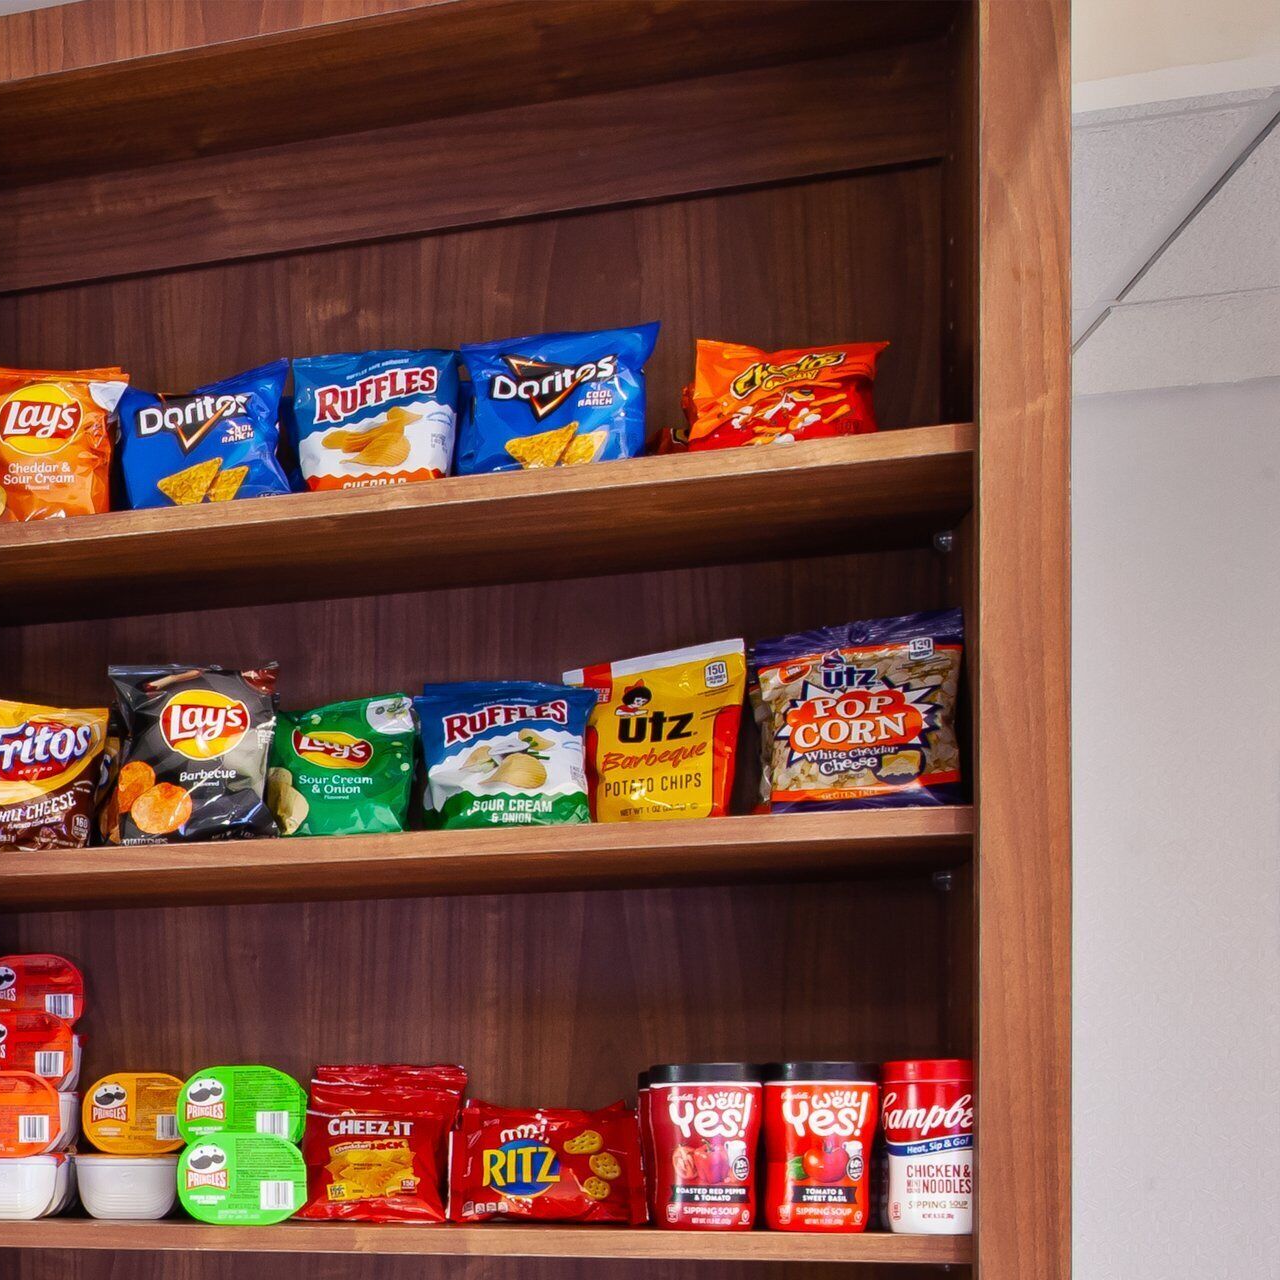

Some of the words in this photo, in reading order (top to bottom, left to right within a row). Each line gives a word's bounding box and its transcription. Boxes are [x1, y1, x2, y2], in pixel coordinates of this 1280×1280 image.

[494, 356, 614, 399] Doritos
[316, 368, 436, 422] RUFFLES
[578, 398, 612, 406] RANCH
[4, 402, 78, 438] Lay's
[139, 396, 249, 435] Doritos
[9, 463, 59, 473] Cheddar
[61, 462, 70, 472] &
[4, 474, 32, 485] Sour
[35, 472, 74, 484] Cream
[707, 664, 724, 675] 150
[811, 696, 893, 718] POP
[169, 705, 244, 740] Lay's
[445, 701, 565, 744] RUFFLES
[795, 713, 905, 748] CORN
[299, 735, 368, 759] Lay's
[805, 751, 846, 761] White
[848, 746, 898, 758] Cheddar
[602, 742, 707, 773] Barbeque
[821, 757, 877, 773] Cheese
[180, 768, 236, 781] Barbecue
[299, 776, 329, 785] Sour
[332, 776, 373, 785] Cream
[312, 785, 321, 794] &
[324, 785, 360, 795] Onion
[605, 778, 653, 797] POTATO
[661, 773, 701, 790] CHIPS
[27, 791, 76, 820] CHEESE
[473, 800, 504, 811] SOUR
[509, 800, 551, 812] CREAM
[502, 813, 531, 822] ONION
[93, 1105, 126, 1122] PRINGLES
[187, 1103, 223, 1120] PRINGLES
[669, 1092, 752, 1138] Yes!
[328, 1119, 413, 1136] CHEEZ-IT
[482, 1148, 561, 1186] RITZ
[907, 1165, 960, 1178] CHICKEN
[963, 1165, 971, 1177] &
[922, 1179, 971, 1194] NOODLES
[683, 1207, 717, 1215] SIPPING
[718, 1207, 739, 1215] SOUP
